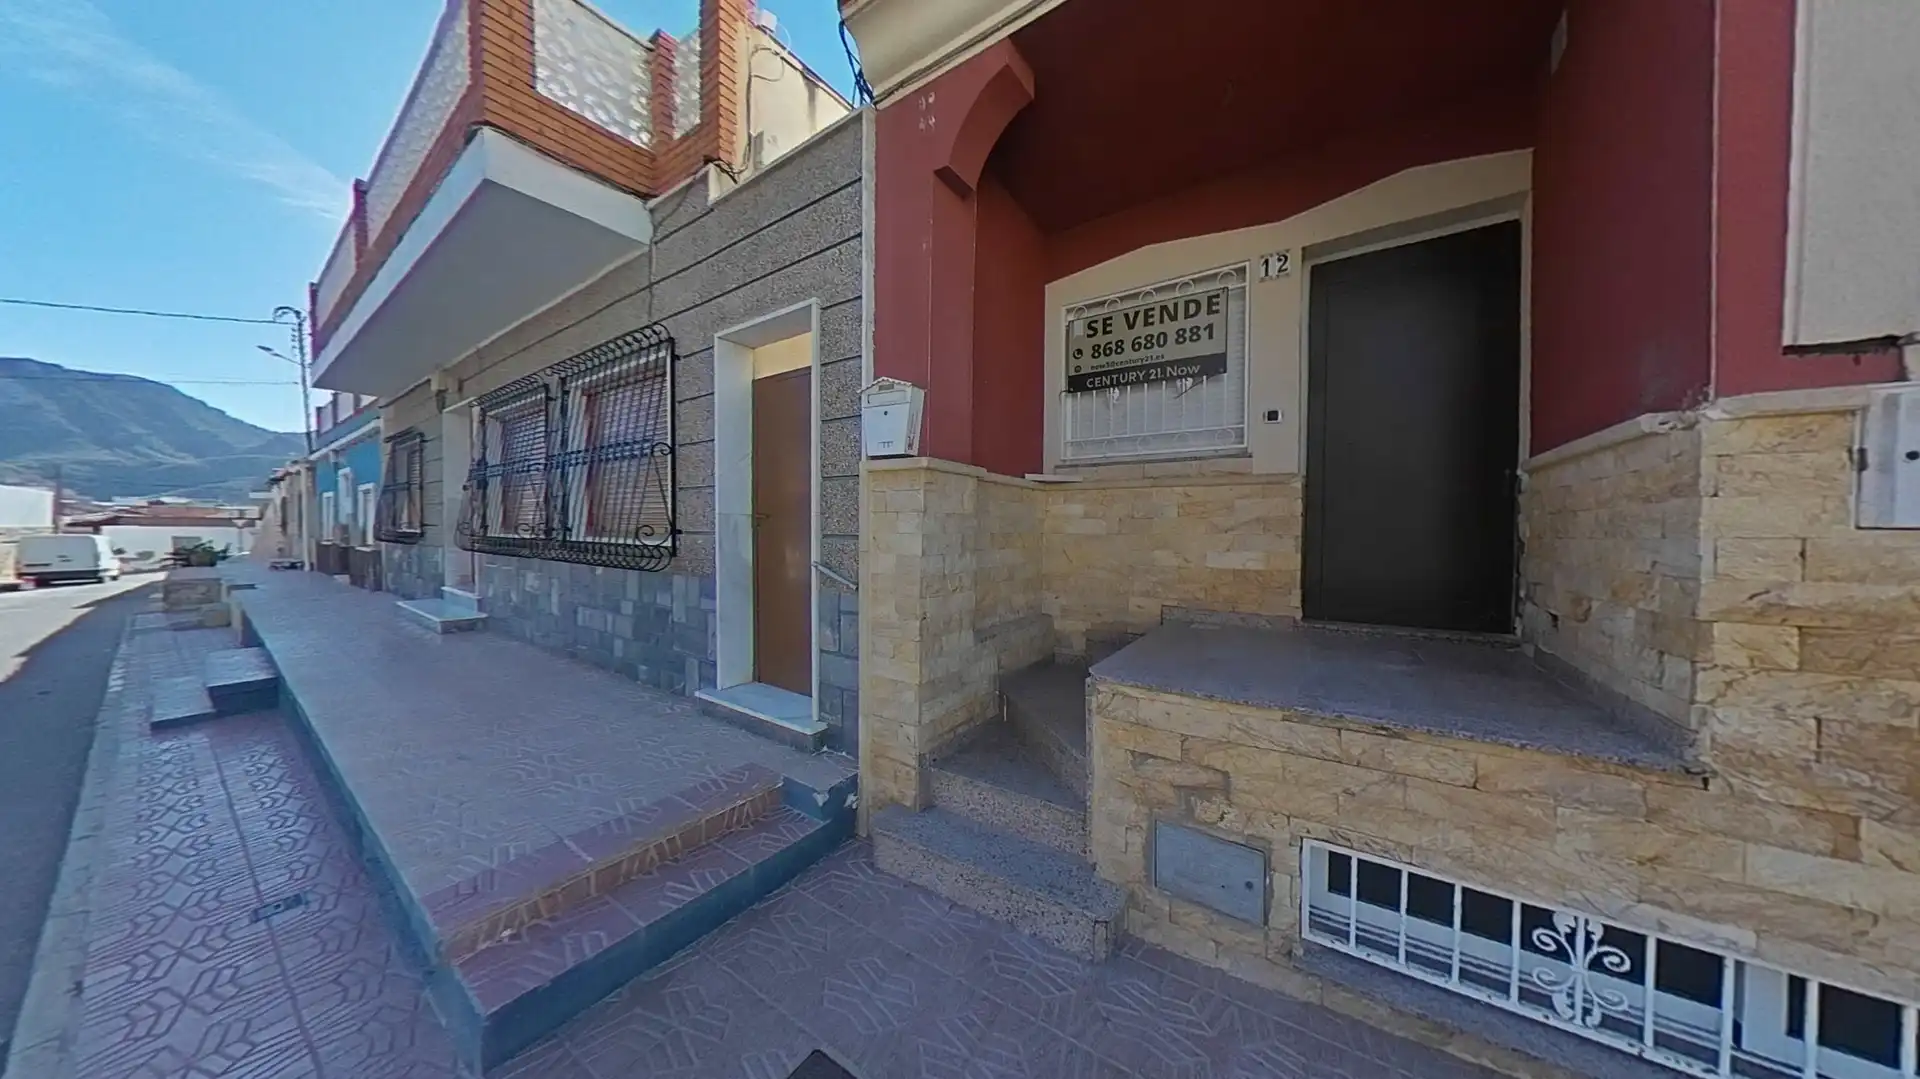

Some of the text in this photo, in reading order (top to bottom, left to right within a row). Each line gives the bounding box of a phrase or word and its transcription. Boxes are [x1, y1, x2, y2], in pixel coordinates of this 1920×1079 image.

[1261, 254, 1289, 278] 12
[1086, 293, 1221, 338] SE VENDE
[1090, 322, 1215, 359] 868 680 881
[1086, 370, 1146, 388] CENTURY
[1166, 364, 1201, 377] Now
